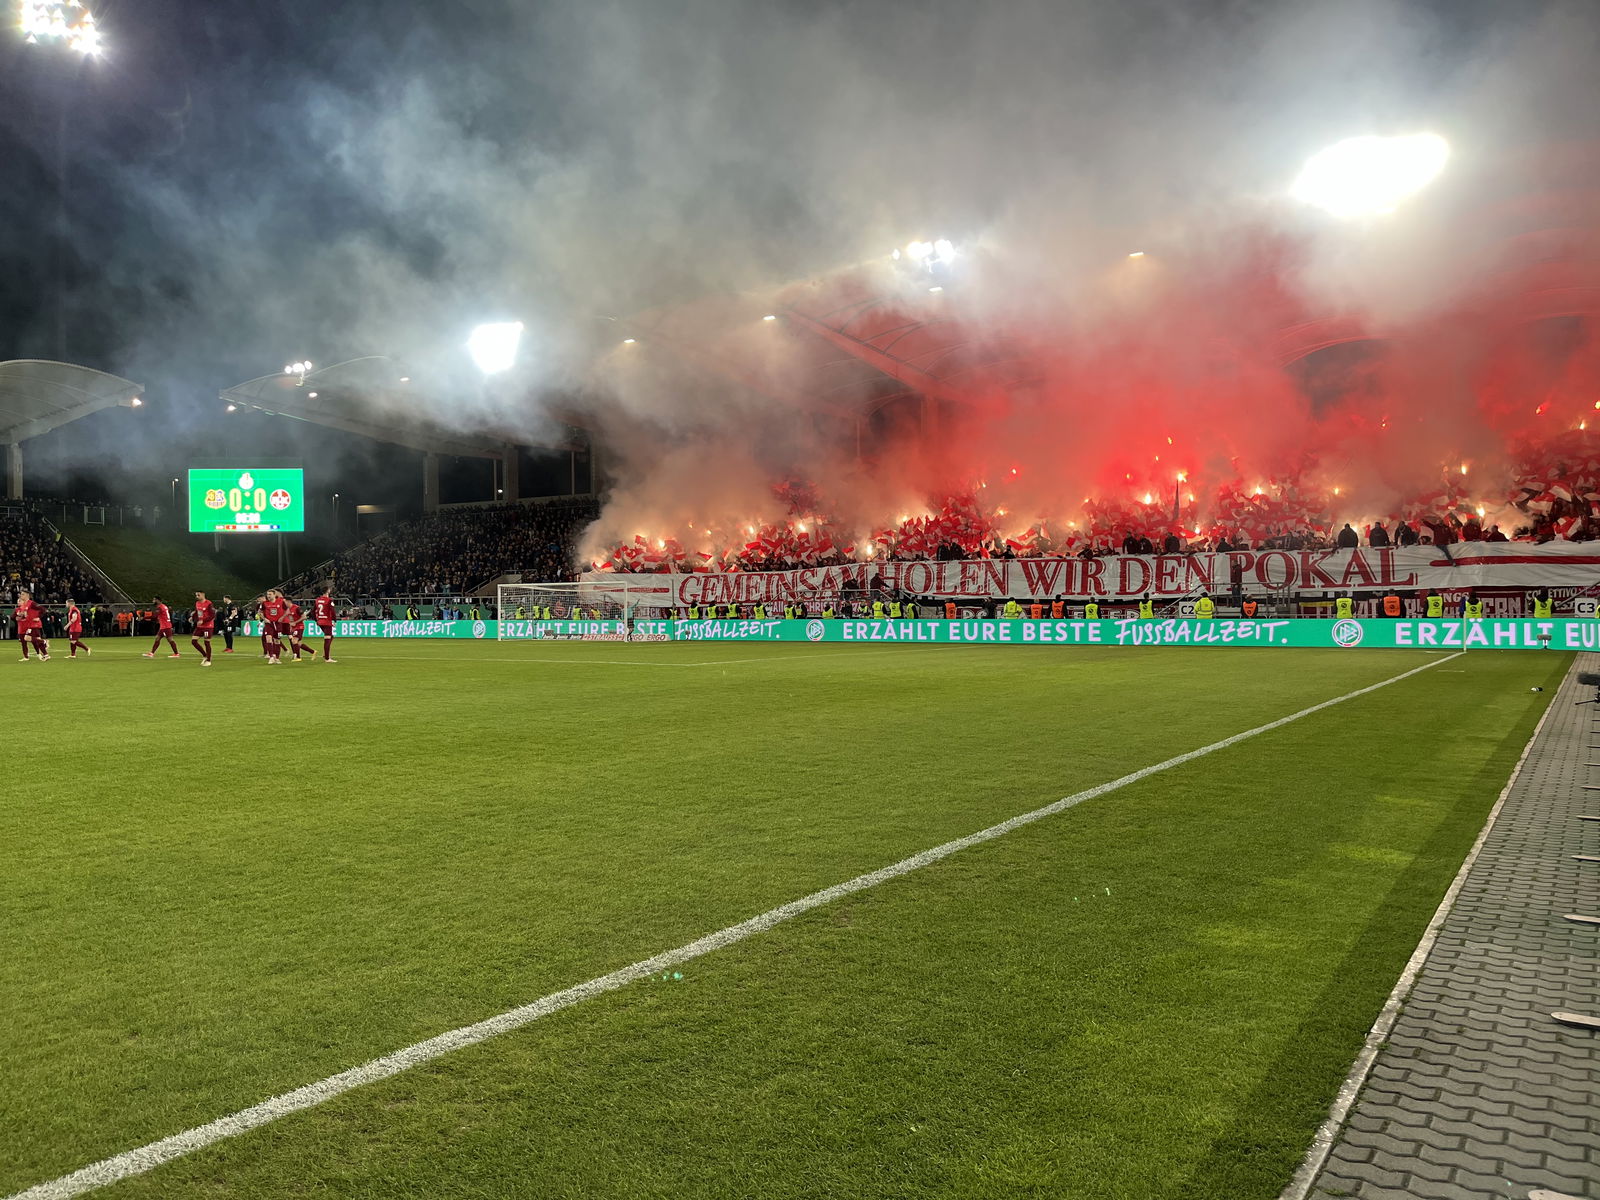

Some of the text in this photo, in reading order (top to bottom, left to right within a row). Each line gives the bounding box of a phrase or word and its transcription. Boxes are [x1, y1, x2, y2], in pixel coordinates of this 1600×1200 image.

[678, 547, 1418, 605] GEMEINSAM HOLEN WIR DEN POKAL
[318, 604, 324, 615] 2
[1181, 605, 1194, 614] C2
[1577, 602, 1595, 613] C3
[308, 623, 337, 635] EUE
[342, 623, 377, 635] BESTE
[617, 623, 667, 636] BSTE
[843, 619, 940, 640] ERZÄHLT
[949, 622, 1011, 641] EURE
[1023, 622, 1102, 642] BESTE
[1395, 618, 1600, 648] ERZÄHLT EU
